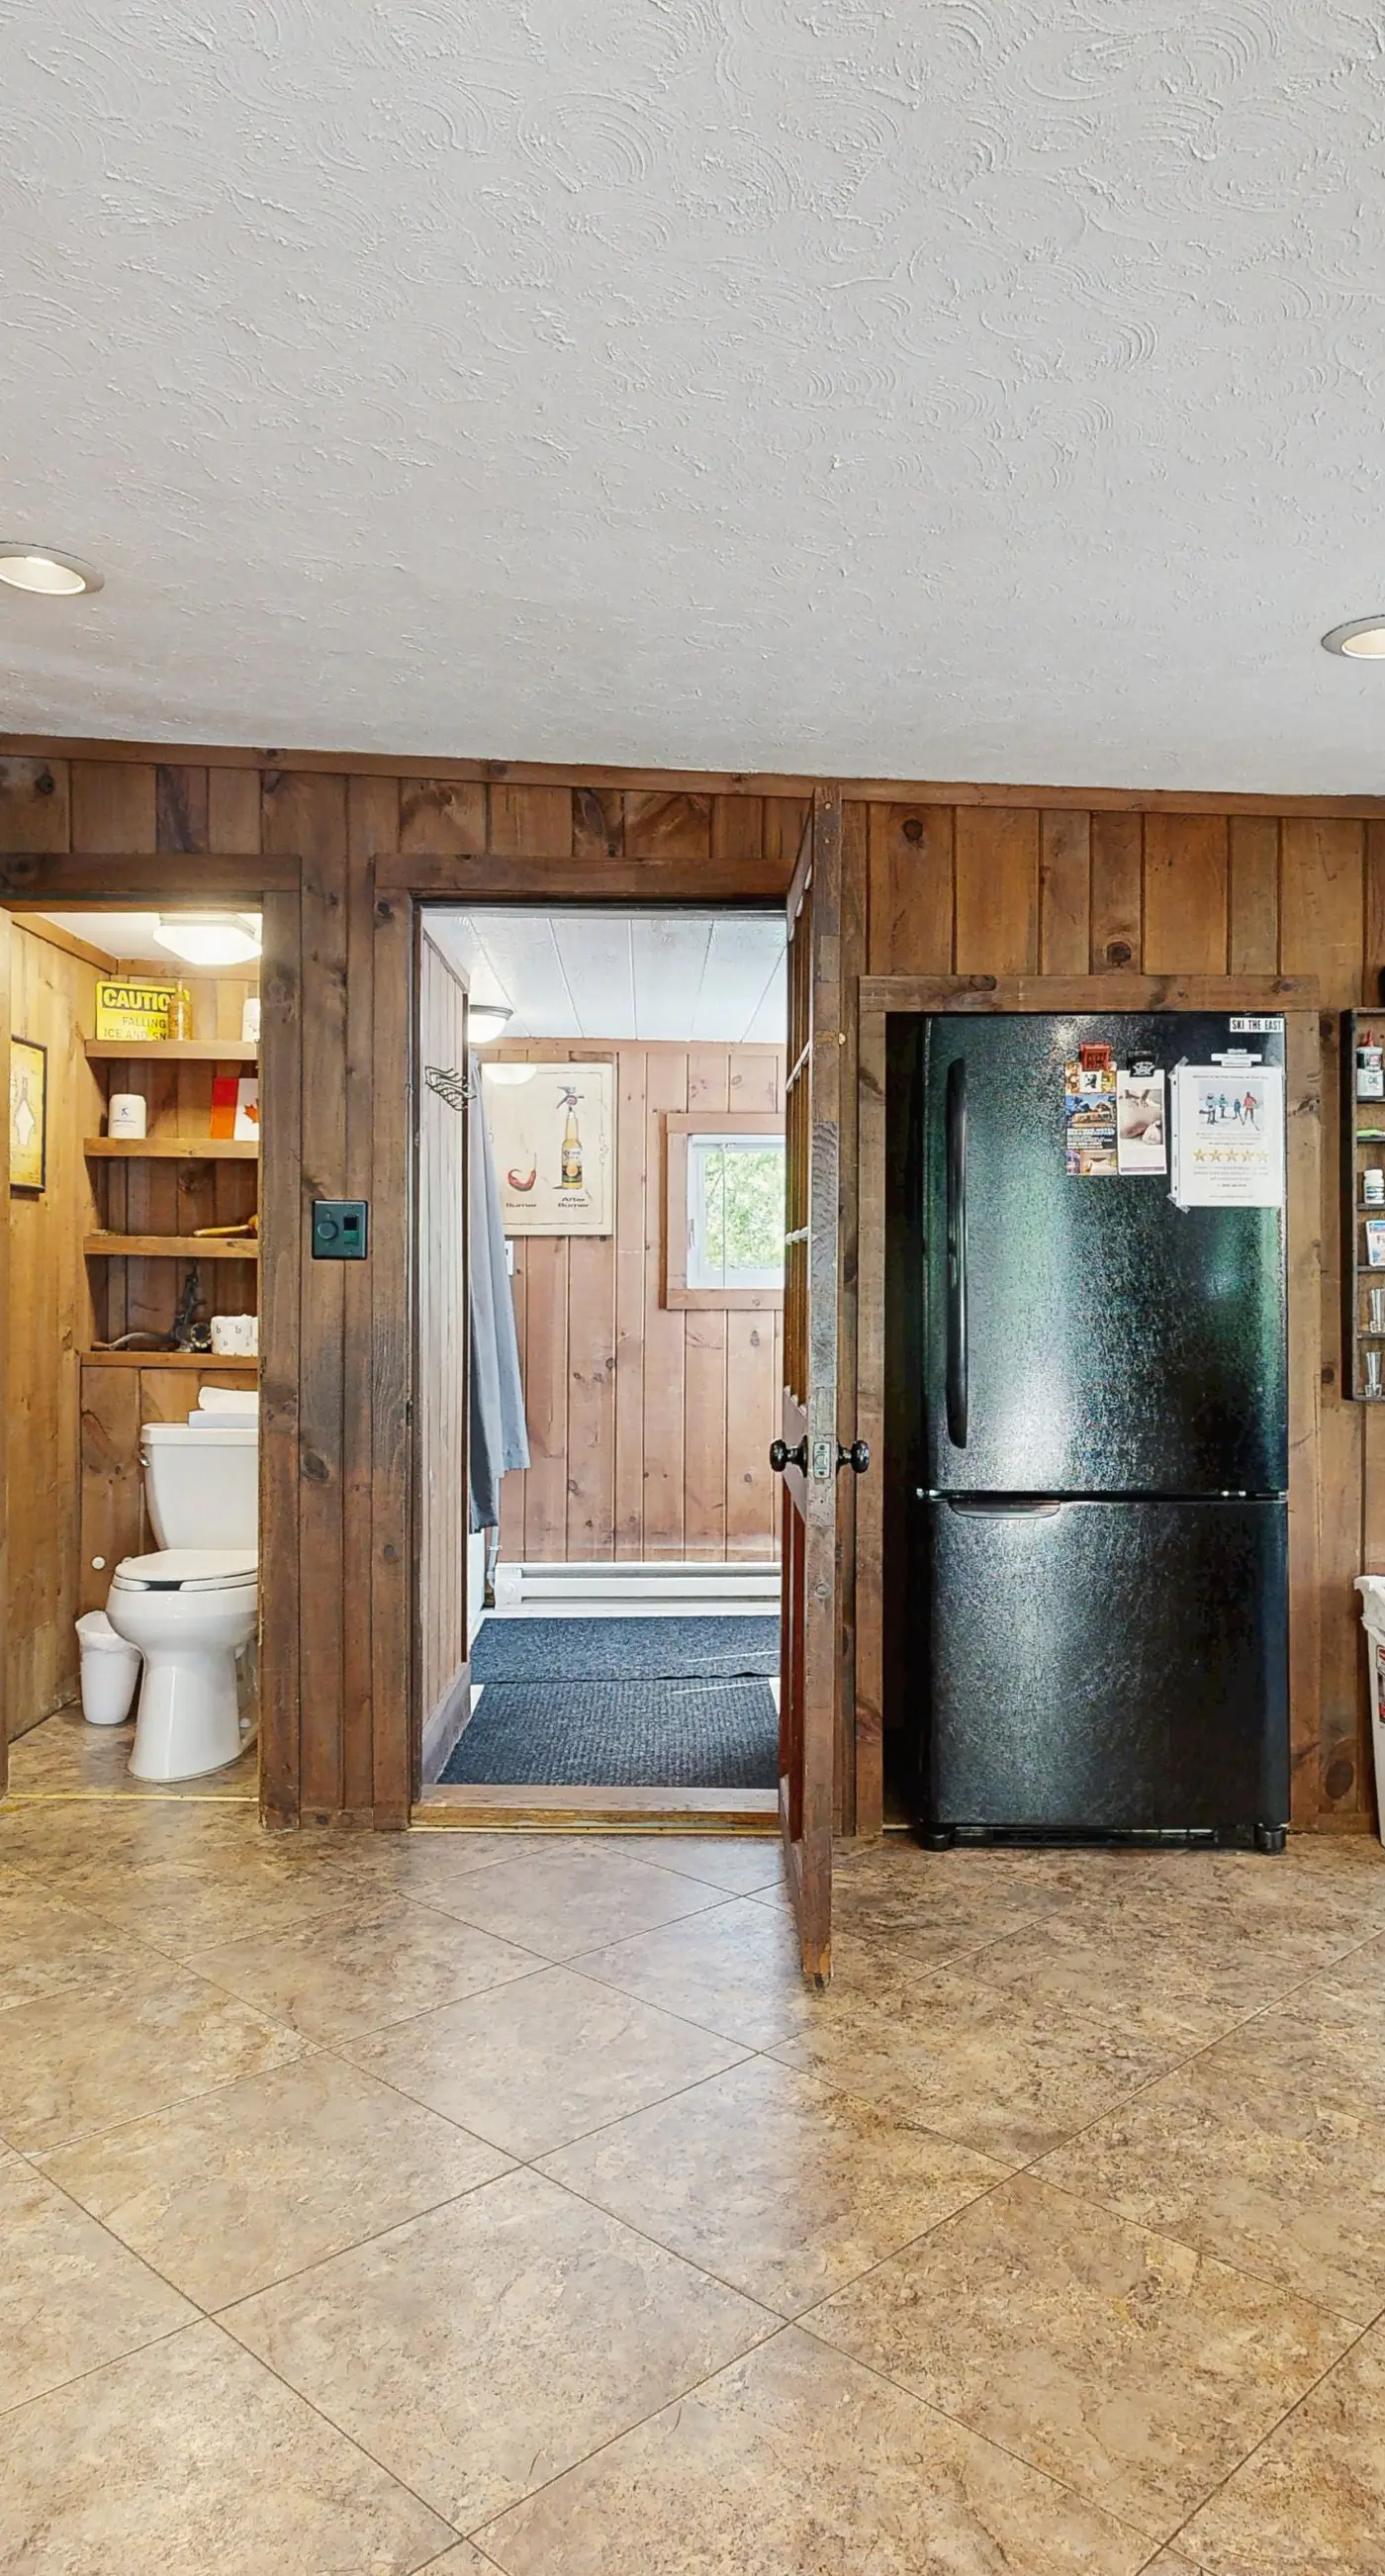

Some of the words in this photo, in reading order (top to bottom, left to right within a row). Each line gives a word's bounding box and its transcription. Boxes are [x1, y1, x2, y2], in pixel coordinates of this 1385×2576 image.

[103, 988, 171, 1012] CAUTIO
[122, 1017, 166, 1029] FALLING
[1233, 1019, 1245, 1030] SKI
[1248, 1019, 1260, 1031] THE
[1265, 1020, 1281, 1031] EAST
[104, 1028, 123, 1039] ICE
